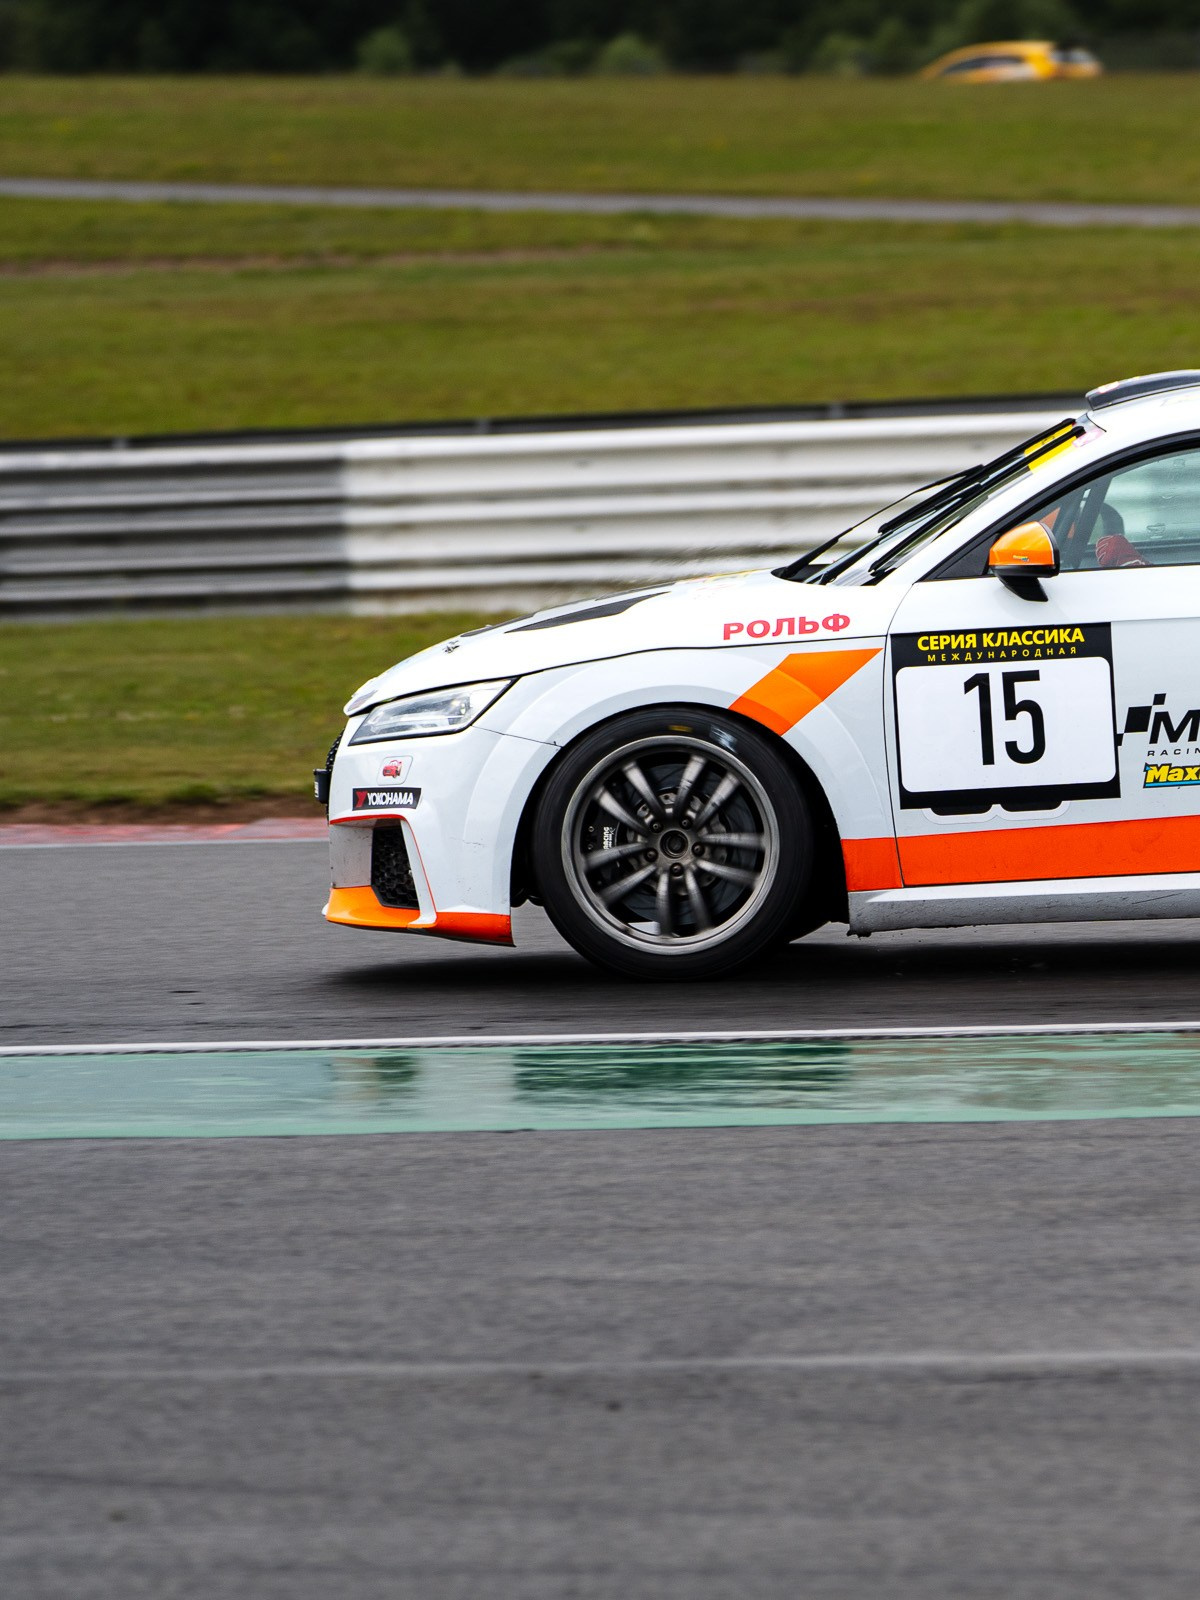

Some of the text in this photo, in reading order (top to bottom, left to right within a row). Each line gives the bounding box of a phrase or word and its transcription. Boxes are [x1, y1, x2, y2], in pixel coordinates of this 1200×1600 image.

[723, 613, 851, 641] РОЛЬФ
[917, 627, 1086, 651] СЕРИЯ КЛАССИКА
[927, 646, 1077, 662] МЕЖДУНАРОДНАЯ
[963, 668, 1046, 767] 15
[366, 792, 414, 806] YOKOHAMA
